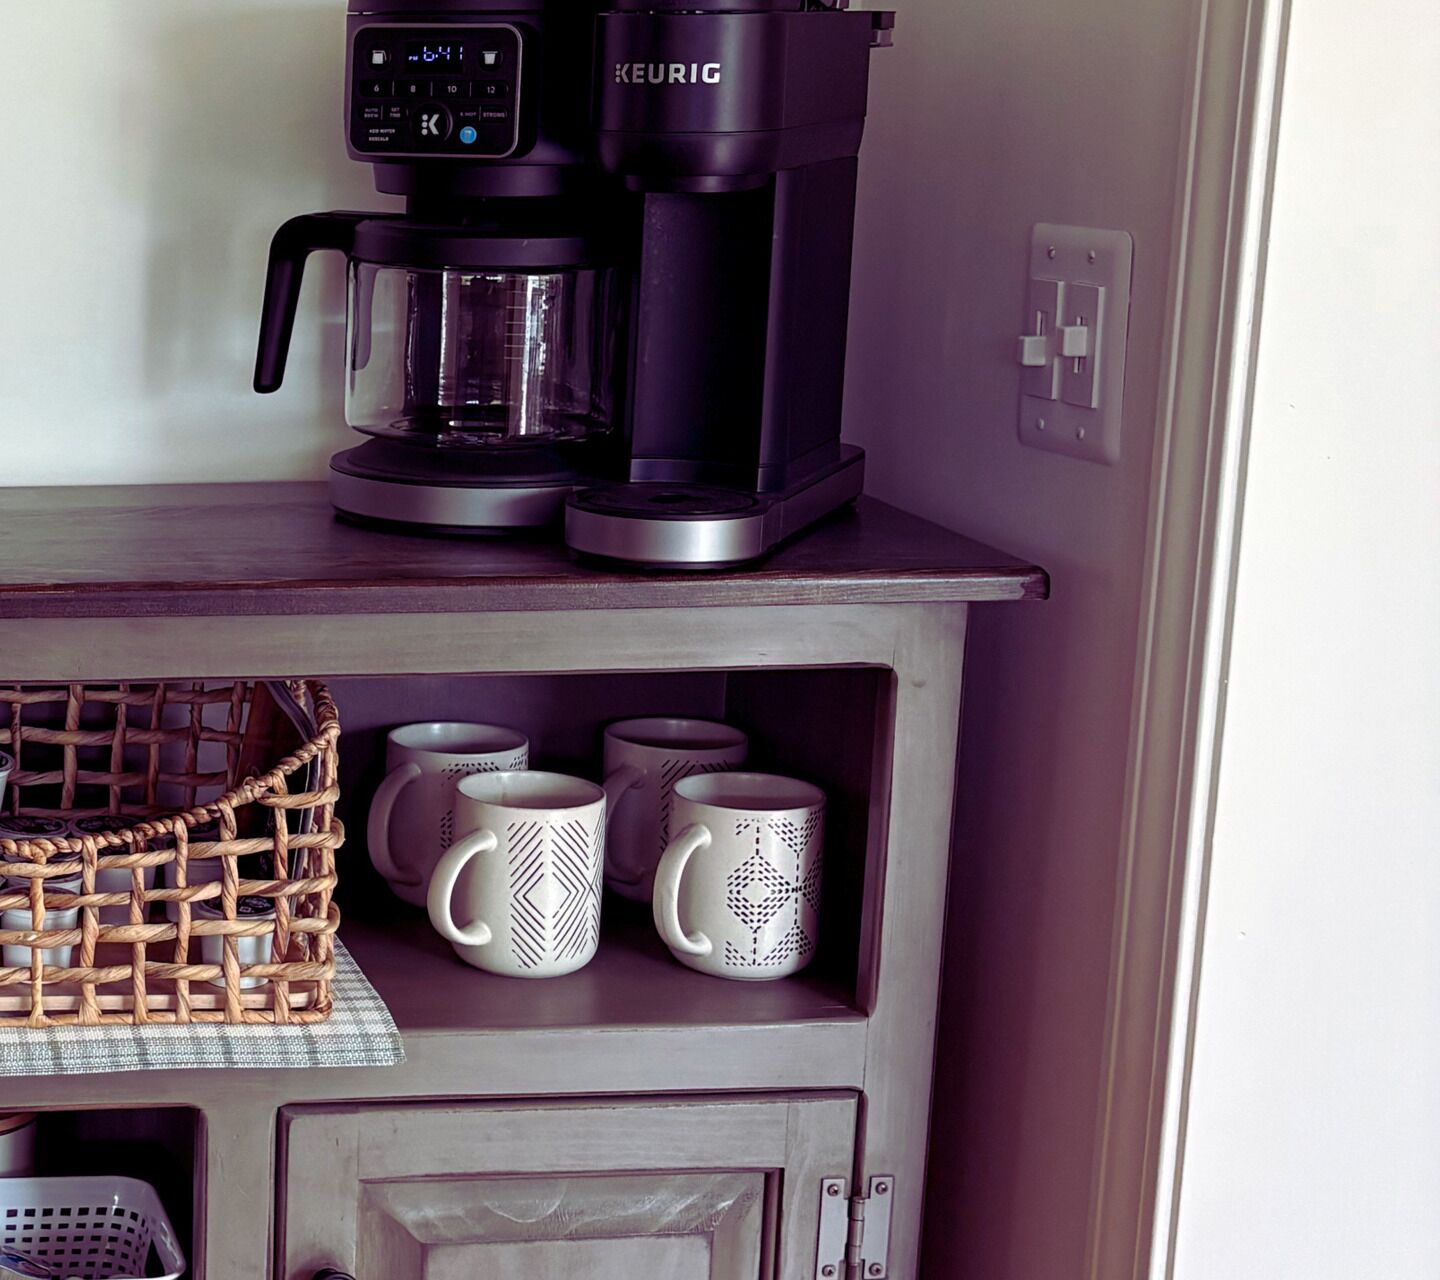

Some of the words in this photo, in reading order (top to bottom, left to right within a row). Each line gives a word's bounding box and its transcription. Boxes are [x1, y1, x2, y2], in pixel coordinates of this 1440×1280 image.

[615, 63, 721, 84] KEURIG
[373, 84, 380, 92] 6
[447, 85, 458, 93] 10
[487, 86, 496, 94] 12
